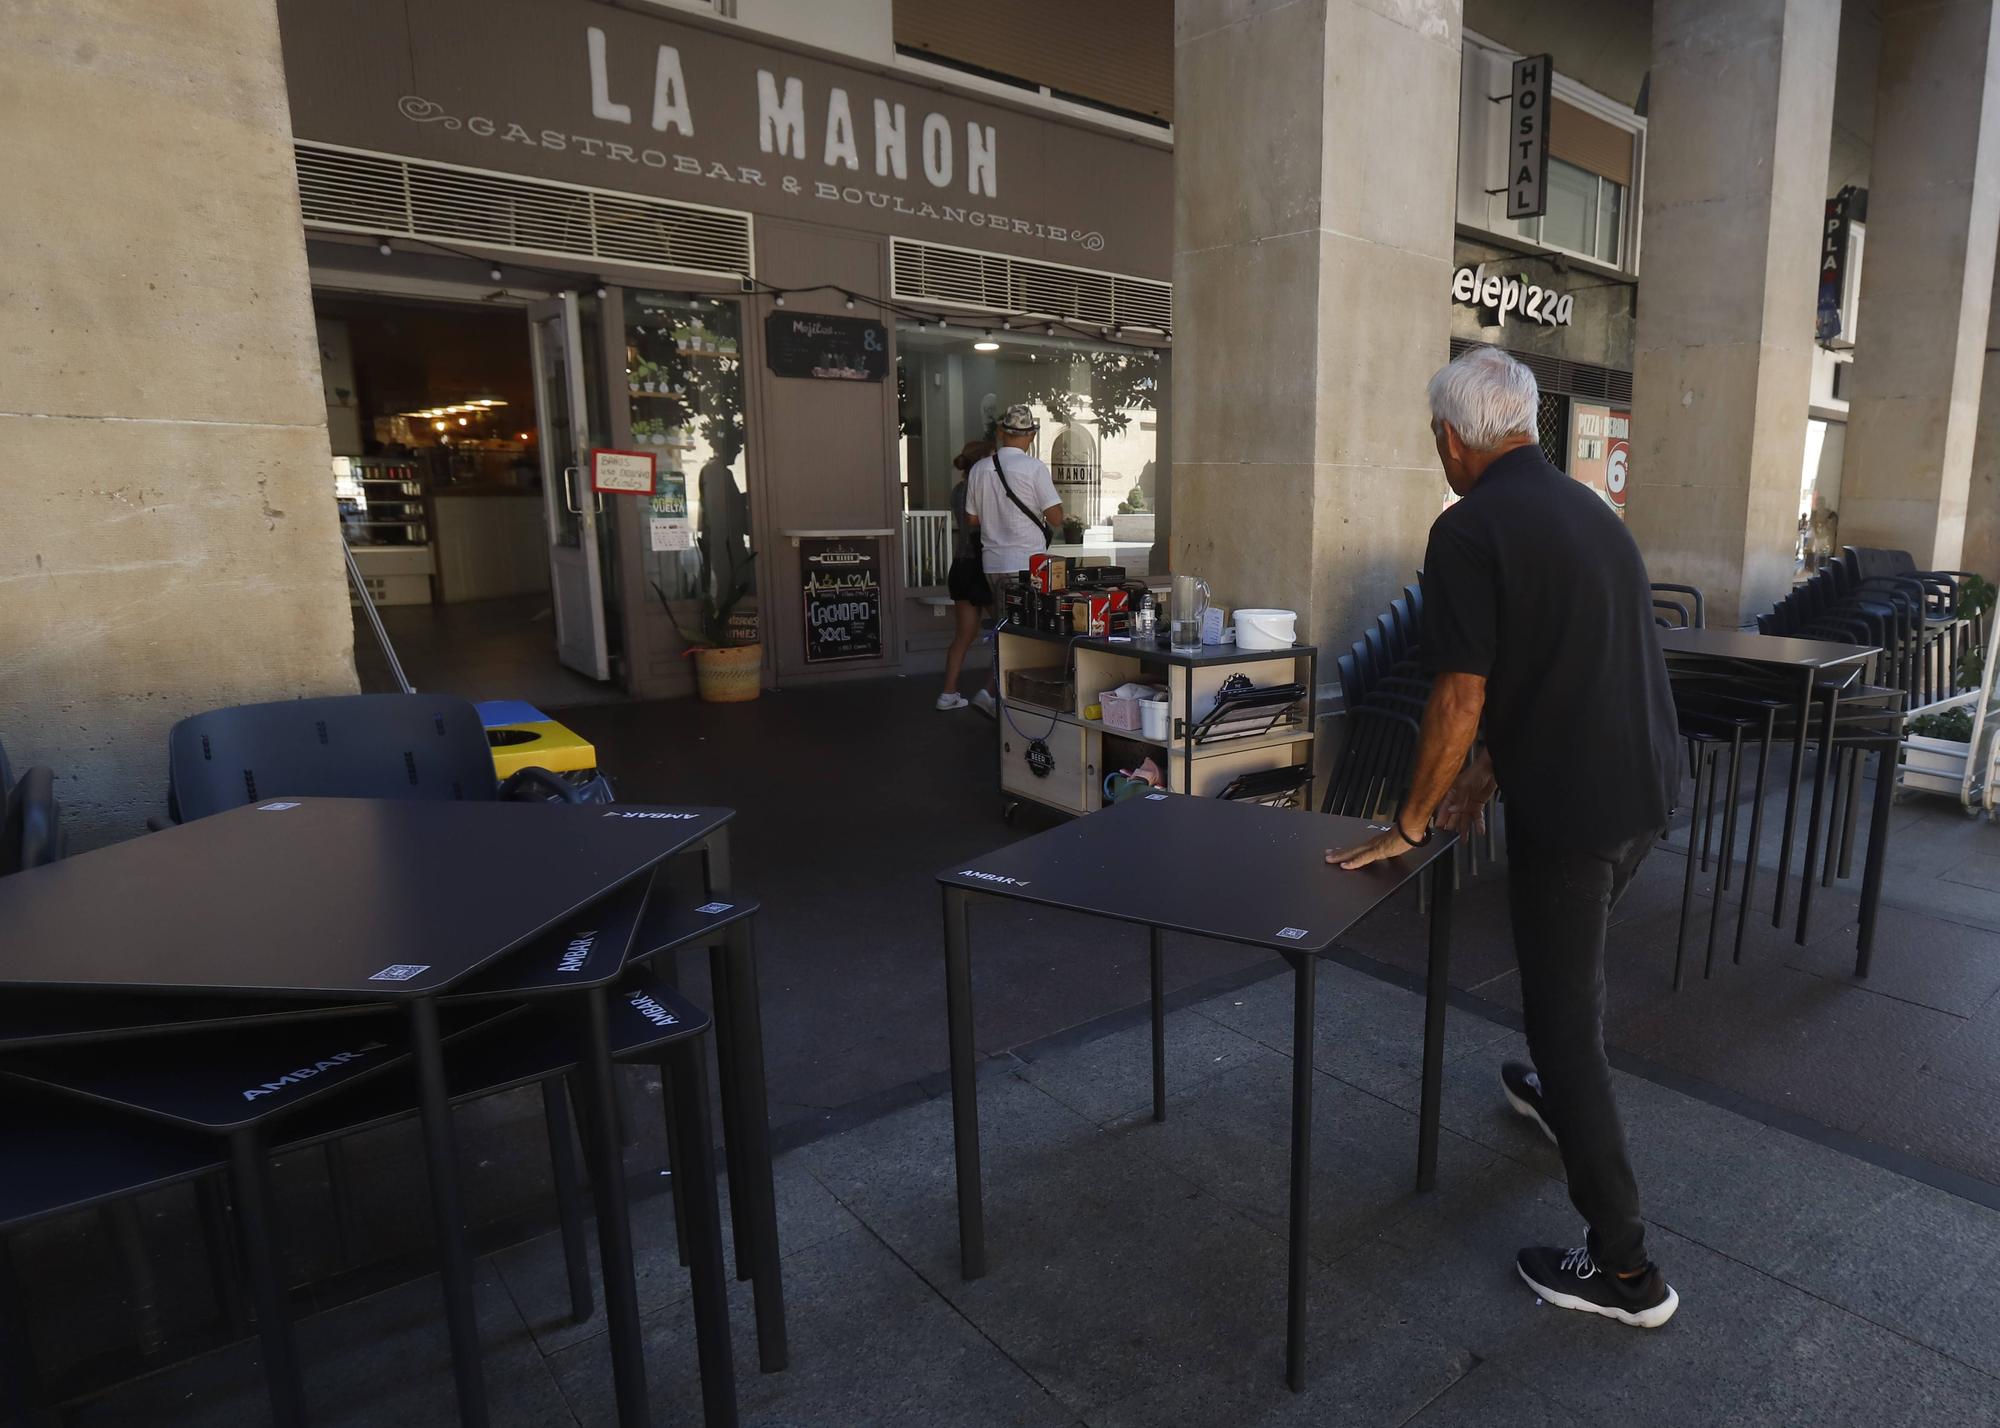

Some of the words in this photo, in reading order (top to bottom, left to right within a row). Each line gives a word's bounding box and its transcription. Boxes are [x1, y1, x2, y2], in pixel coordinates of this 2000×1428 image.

[587, 26, 694, 137] LA
[757, 69, 998, 198] MANON
[1515, 64, 1537, 211] HOSTAL
[467, 115, 767, 186] GASTROBAR
[781, 175, 802, 195] &
[815, 181, 1068, 241] BOULANGERIE
[1451, 262, 1574, 327] elepizza
[1578, 413, 1600, 436] PIZZA
[1057, 467, 1092, 481] MANON
[811, 601, 869, 627] CACHOPO
[818, 626, 851, 643] XXL
[621, 810, 701, 821] AMBAR
[957, 869, 1017, 886] AMBAR
[556, 936, 594, 973] AMBAR
[630, 996, 680, 1028] AMBAR
[241, 1049, 369, 1103] AMBAR
